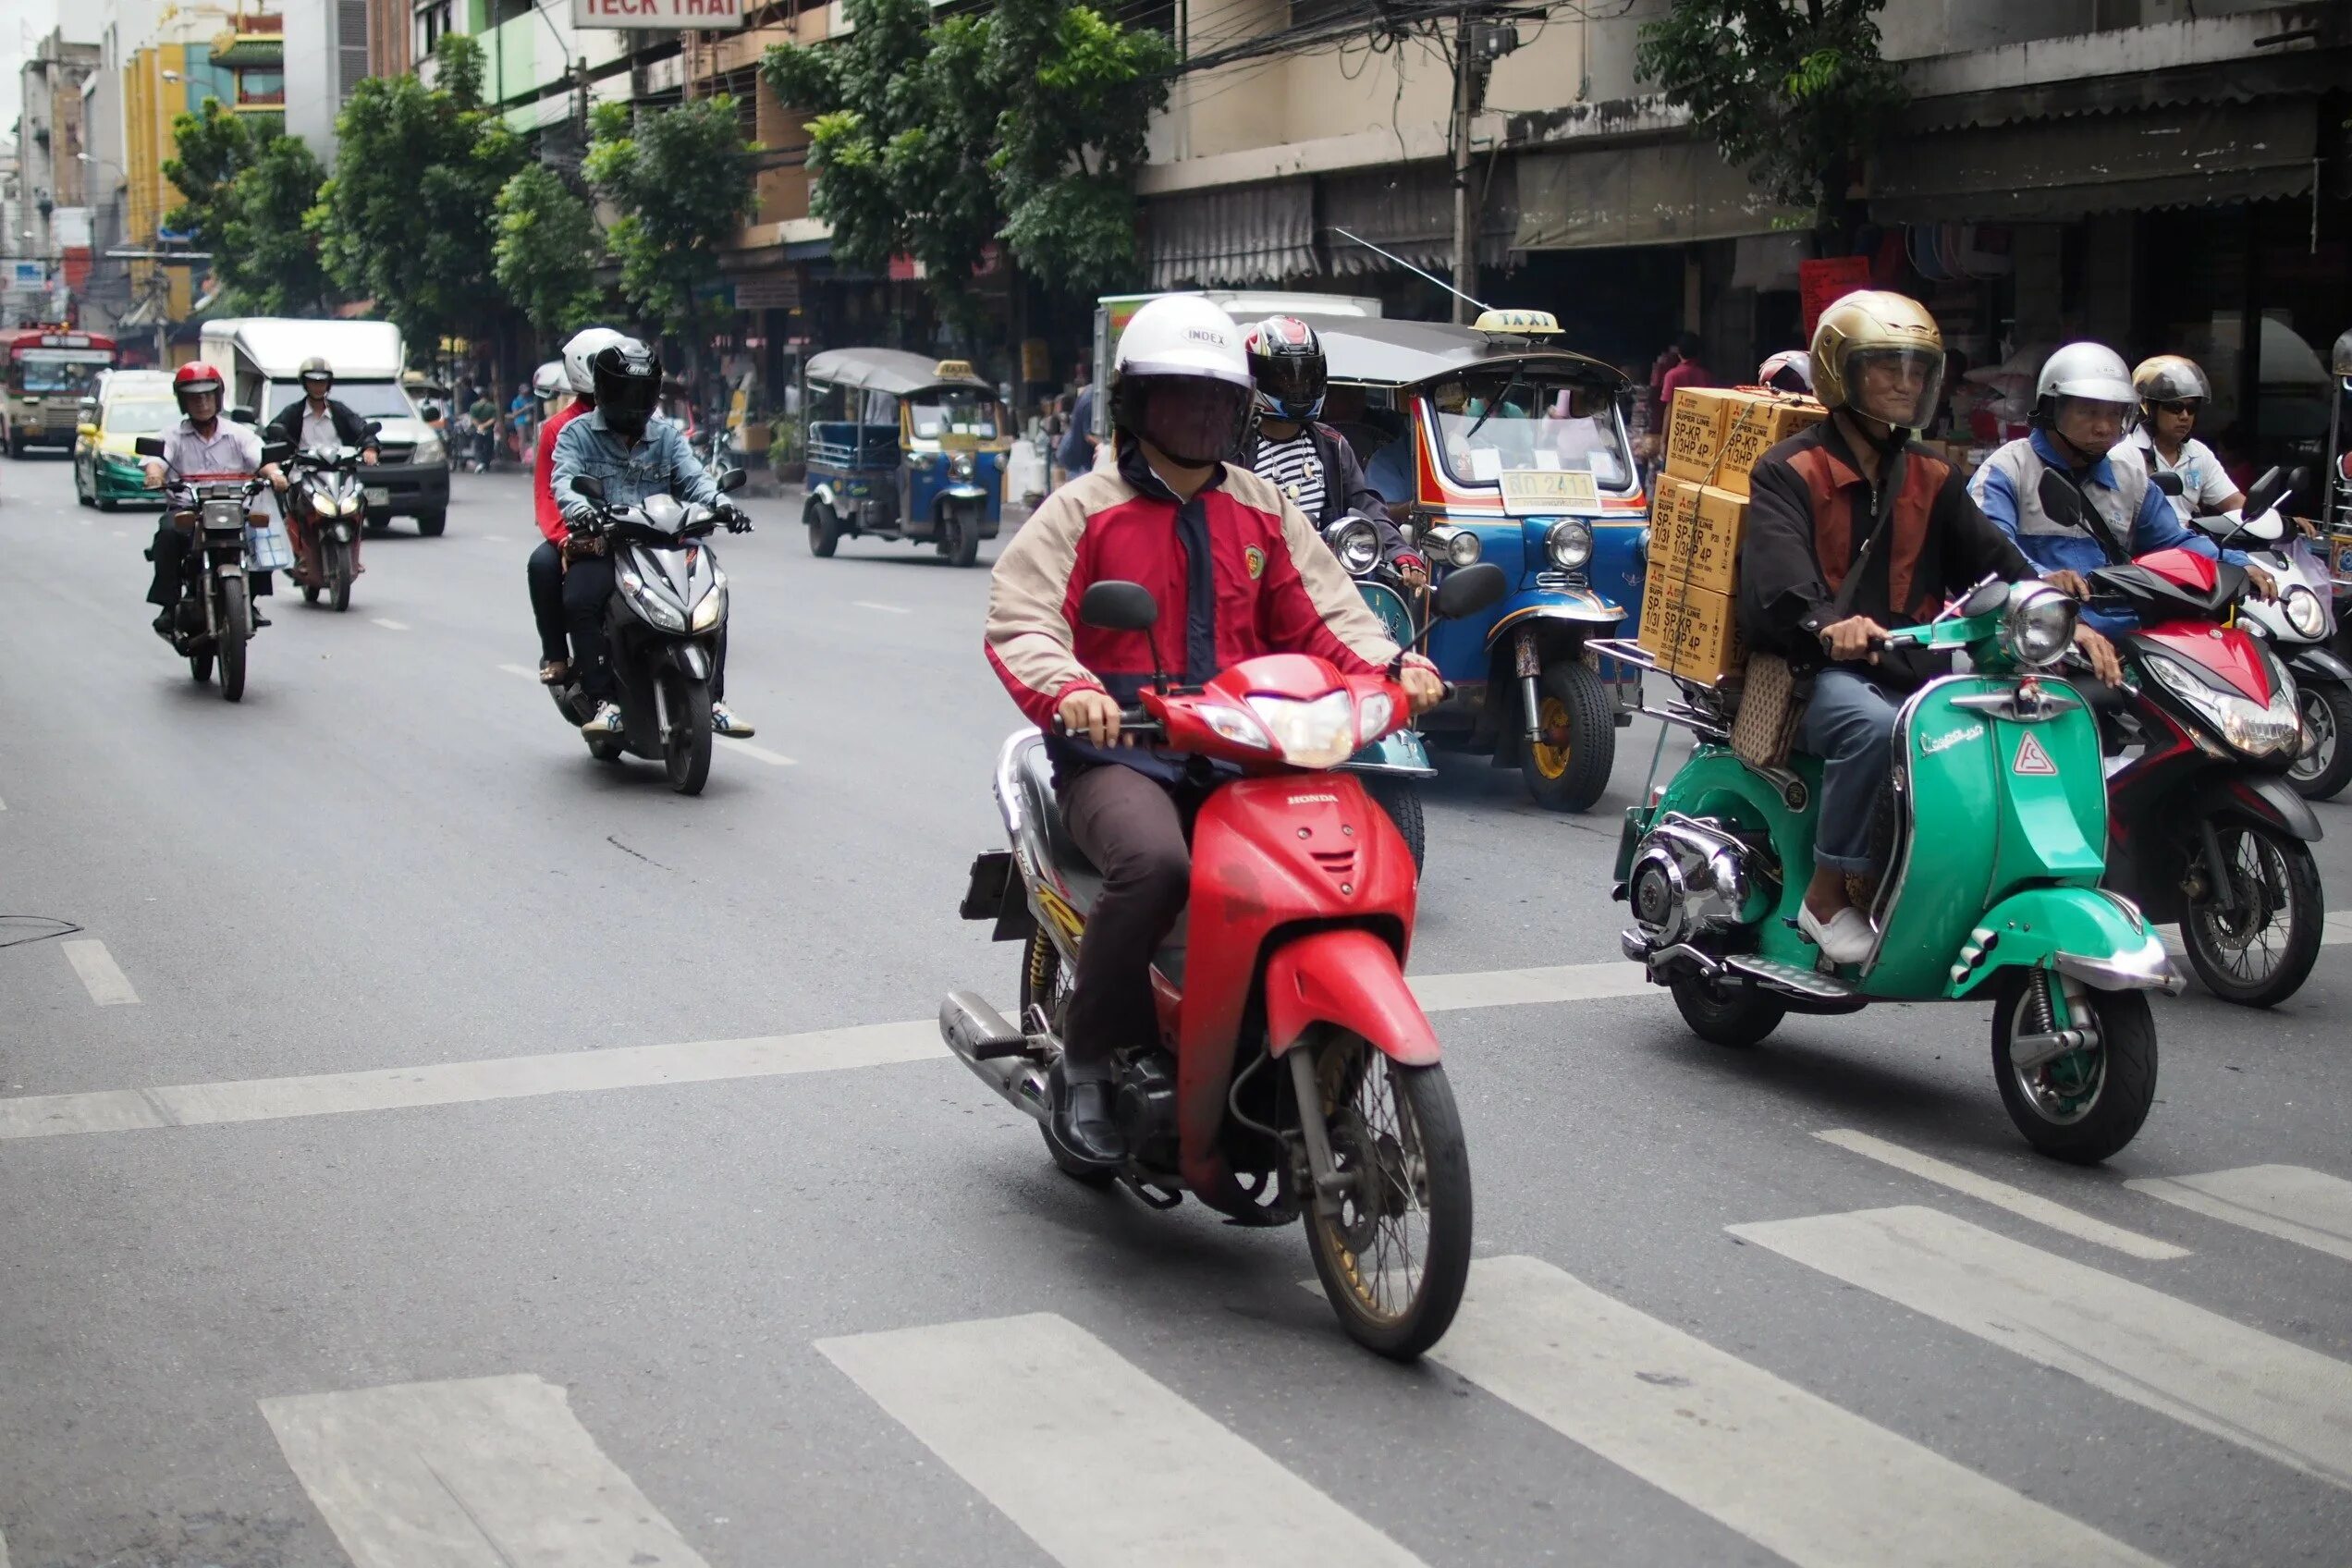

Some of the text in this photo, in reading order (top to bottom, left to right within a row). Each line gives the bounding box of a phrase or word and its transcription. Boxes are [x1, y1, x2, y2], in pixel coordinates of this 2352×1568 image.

[1499, 312, 1550, 326] TAXI
[1188, 329, 1226, 347] INDEX
[1675, 412, 1696, 423] SUPER
[1697, 417, 1710, 427] LINE
[1753, 427, 1768, 437] LINE
[1672, 436, 1709, 459] 1/3HP 4P
[1727, 447, 1753, 466] 1/3HP
[1698, 521, 1713, 531] LINE
[1699, 546, 1712, 563] 4P
[1686, 609, 1701, 619] LINE
[1688, 635, 1700, 651] 4P
[1286, 794, 1340, 804] HONDA
